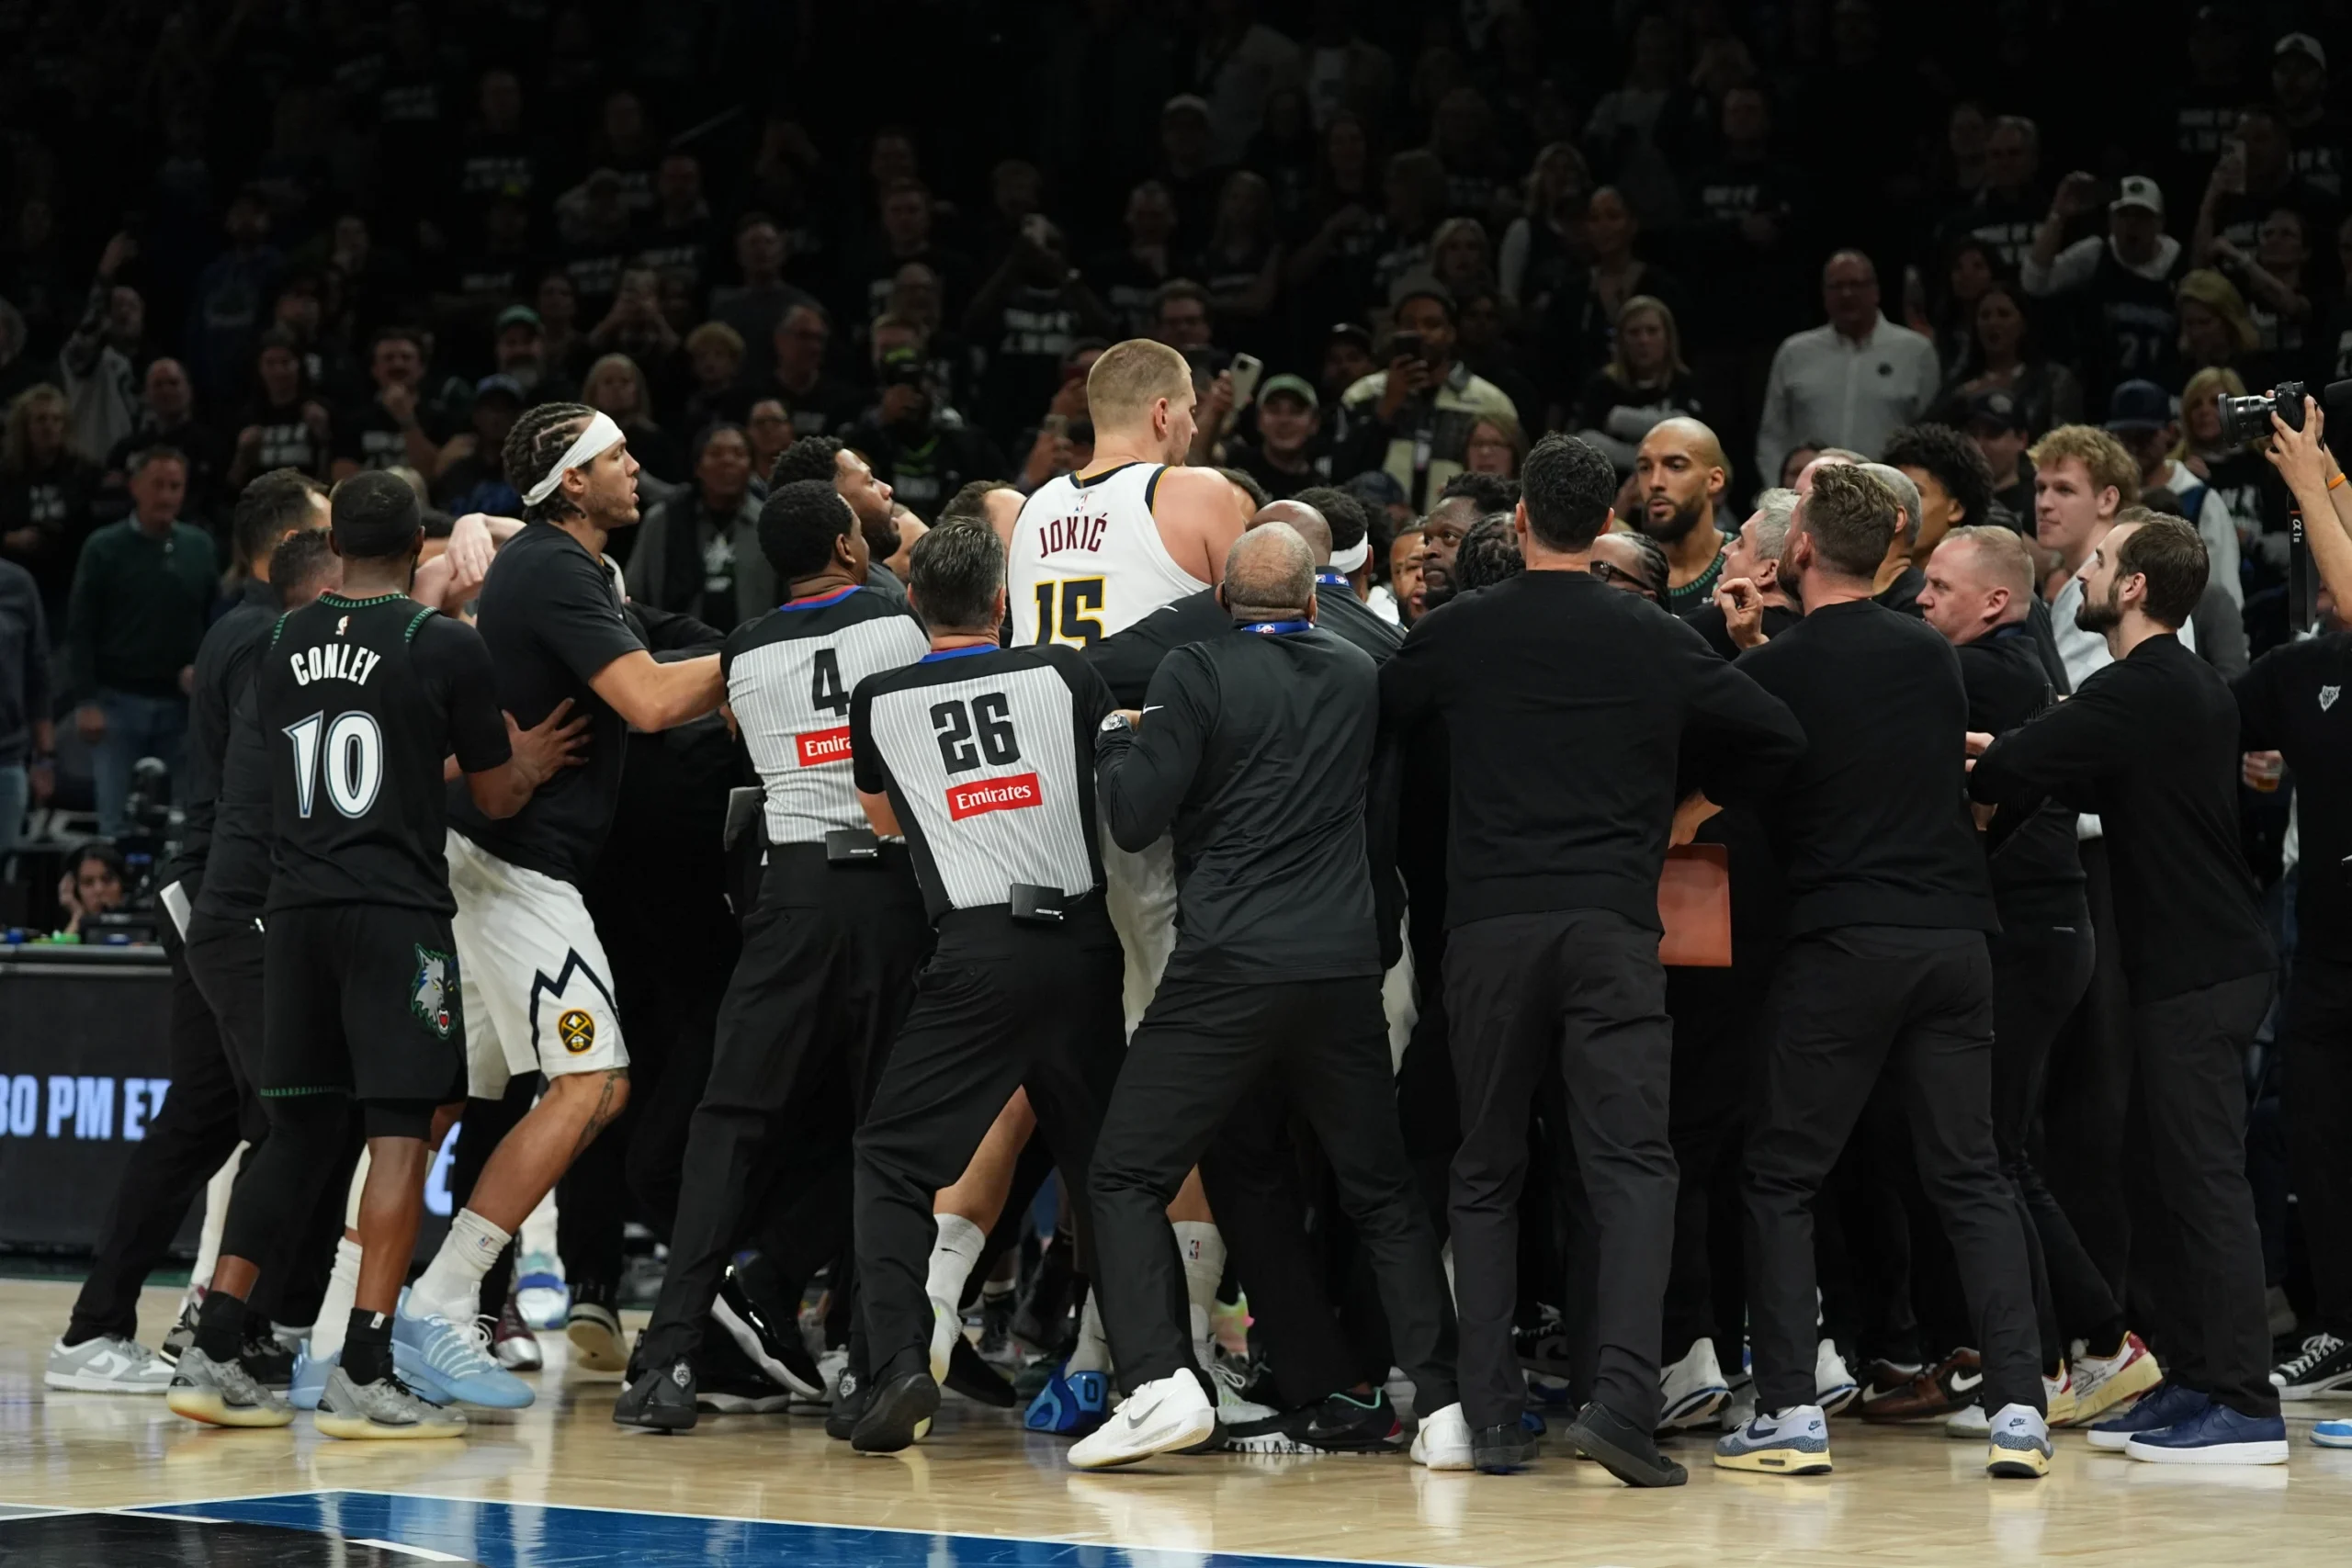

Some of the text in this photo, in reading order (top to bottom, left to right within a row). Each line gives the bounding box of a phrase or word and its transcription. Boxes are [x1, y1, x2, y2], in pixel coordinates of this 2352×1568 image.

[1040, 513, 1108, 558] JOKIĆ
[1034, 575, 1106, 649] 15
[290, 643, 381, 686] CONLEY
[812, 648, 851, 717] 4
[281, 709, 383, 818] 10
[929, 692, 1022, 775] 26
[956, 784, 1032, 810] Emirates
[47, 1075, 115, 1140] PM
